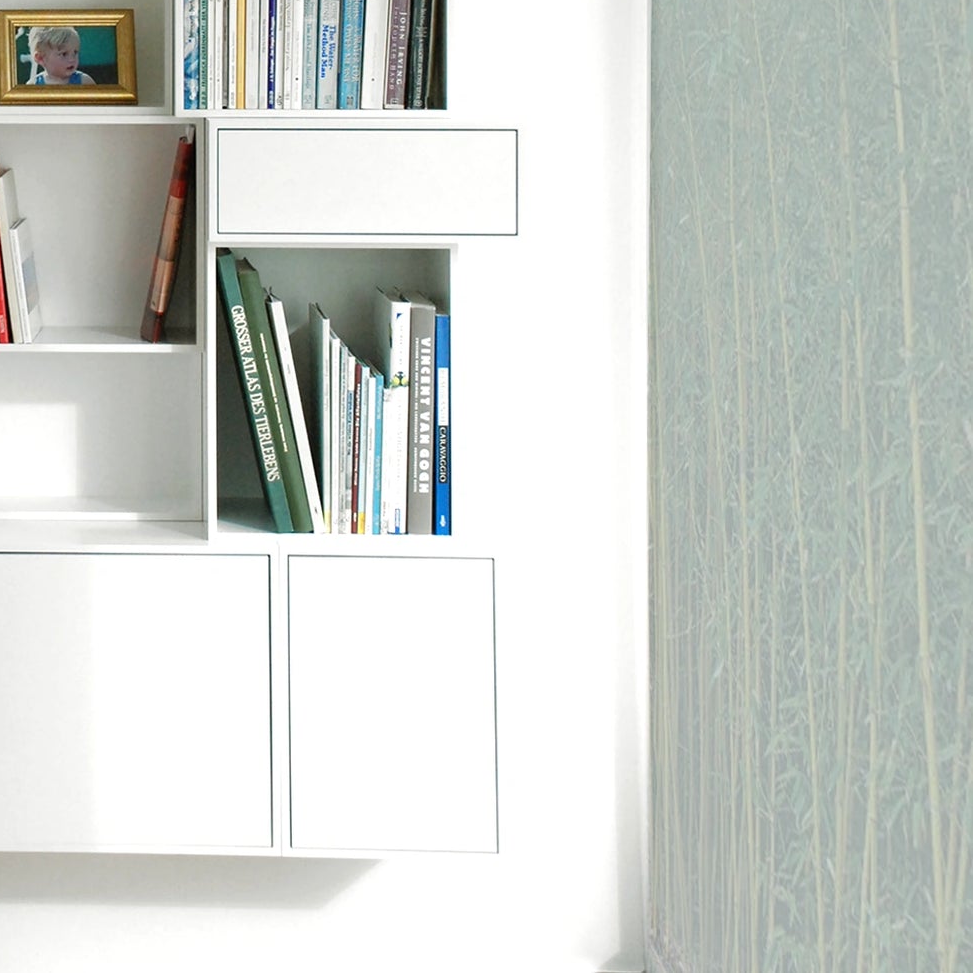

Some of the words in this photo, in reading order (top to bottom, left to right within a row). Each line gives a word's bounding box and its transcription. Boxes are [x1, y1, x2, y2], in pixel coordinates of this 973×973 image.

[321, 24, 329, 57] Method
[328, 25, 336, 41] The
[399, 12, 407, 40] JOHN
[396, 46, 405, 85] IRVING
[231, 305, 253, 355] GROSSER
[241, 356, 261, 392] ATLAS
[420, 337, 431, 405] VINCENT
[250, 394, 265, 415] DES
[419, 412, 430, 444] VAN
[255, 415, 280, 482] TIERLEBENS
[439, 426, 447, 483] CARAVAGGIO
[419, 449, 430, 493] GOGH
